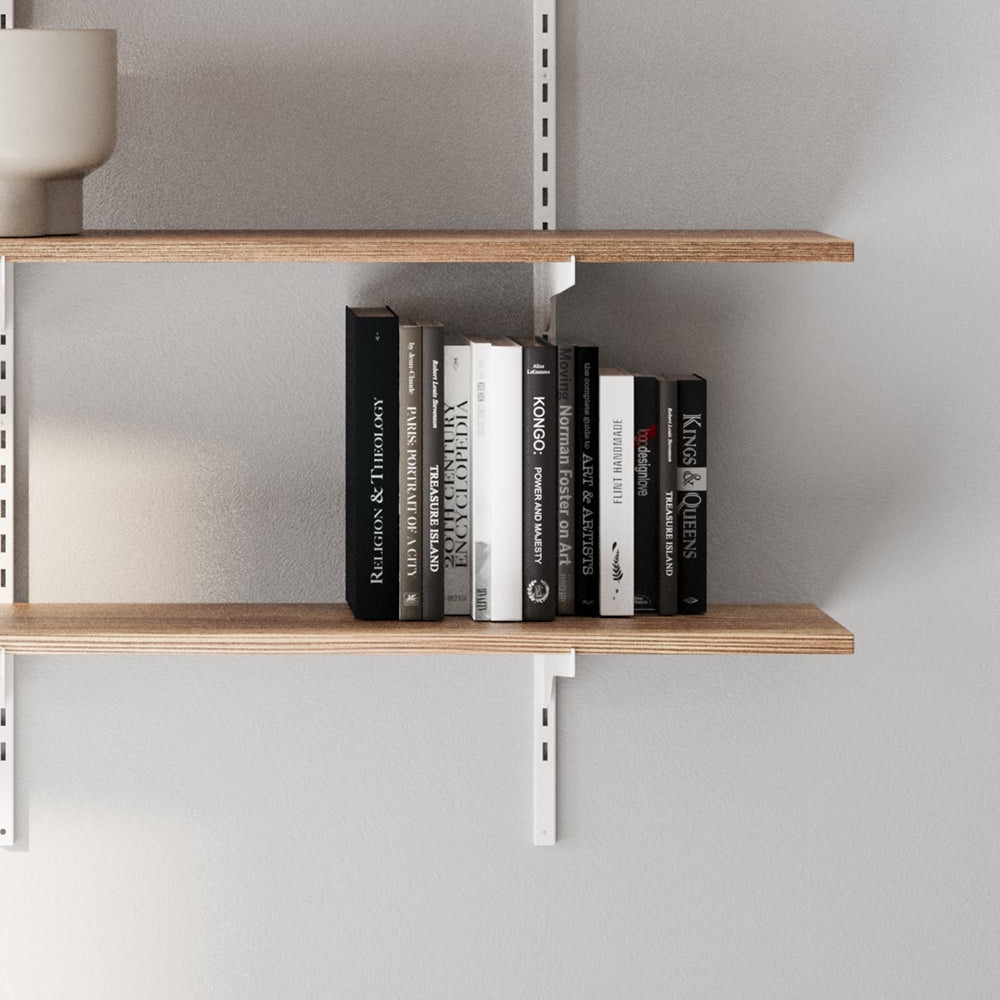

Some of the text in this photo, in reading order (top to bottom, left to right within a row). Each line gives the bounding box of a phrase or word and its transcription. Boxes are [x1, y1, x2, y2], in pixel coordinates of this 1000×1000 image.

[559, 347, 572, 402] Moving
[583, 378, 591, 416] complete
[533, 396, 546, 455] KONGO:
[559, 405, 573, 465] Norman
[583, 416, 591, 440] guide
[584, 441, 590, 450] to
[613, 419, 623, 504] FLINT HANDMADE
[634, 428, 651, 497] logodesignlove
[370, 397, 384, 584] RELIGION & THEOLOGY
[406, 406, 417, 577] PARIS: PORTRAIT OF A CITY
[429, 464, 439, 573] TREASURE ISLAND
[444, 402, 455, 569] 20TH CENTURY
[455, 400, 468, 568] ENCYCLOPEDIA
[534, 467, 543, 565] POWER AND MAJESTY
[559, 470, 573, 516] Foster
[582, 452, 594, 575] ART & ARTISTS
[677, 413, 702, 559] KINGS & QUEENS
[559, 520, 569, 539] on
[559, 542, 572, 566] Art
[665, 491, 674, 577] TREASURE ISLAND
